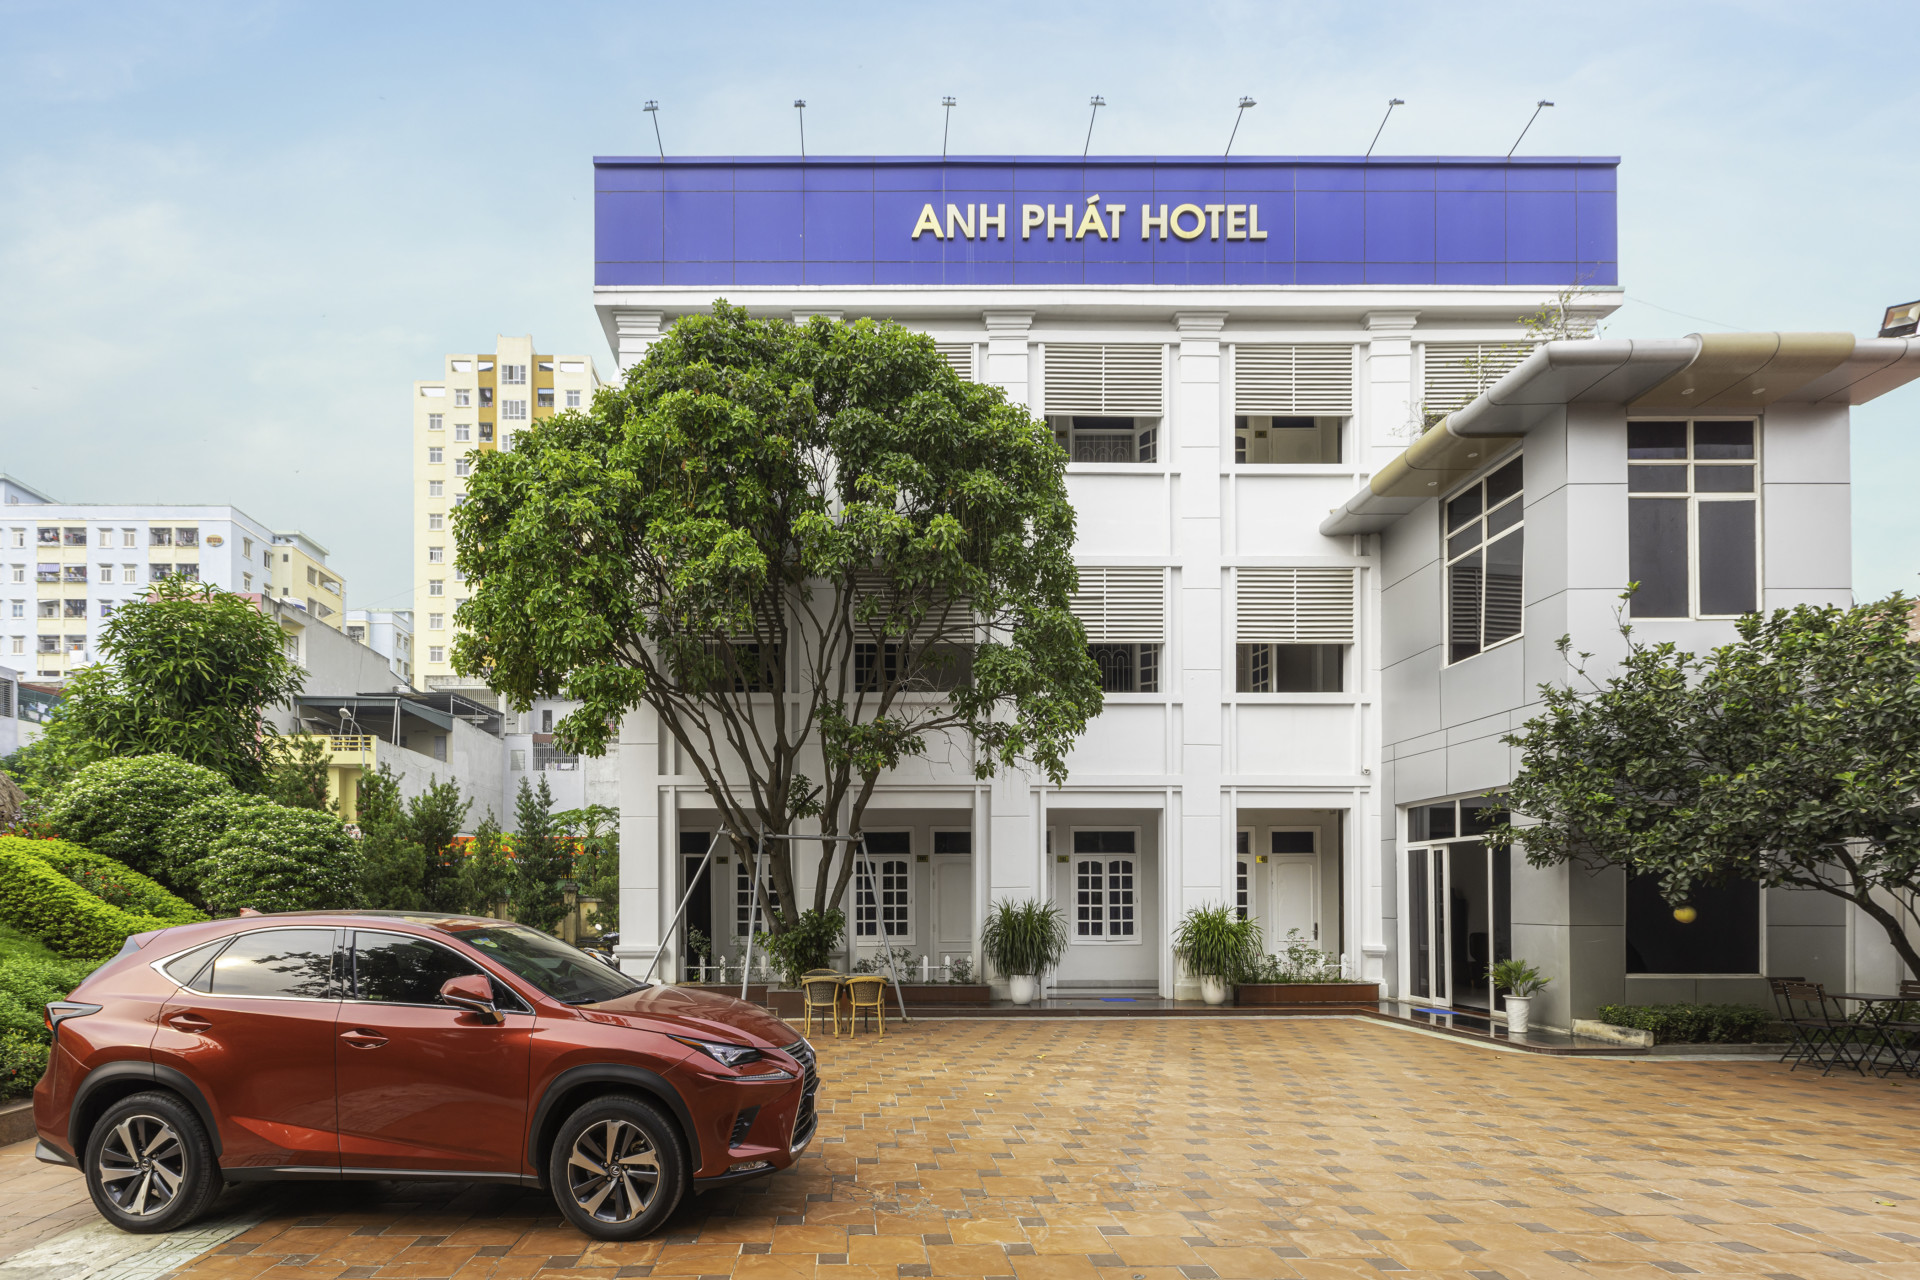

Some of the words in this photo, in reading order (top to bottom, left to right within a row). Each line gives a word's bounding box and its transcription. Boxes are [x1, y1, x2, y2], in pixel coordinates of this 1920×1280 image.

[911, 203, 1006, 240] ANH
[1022, 193, 1126, 240] PHÁT
[1141, 203, 1268, 240] HOTEL
